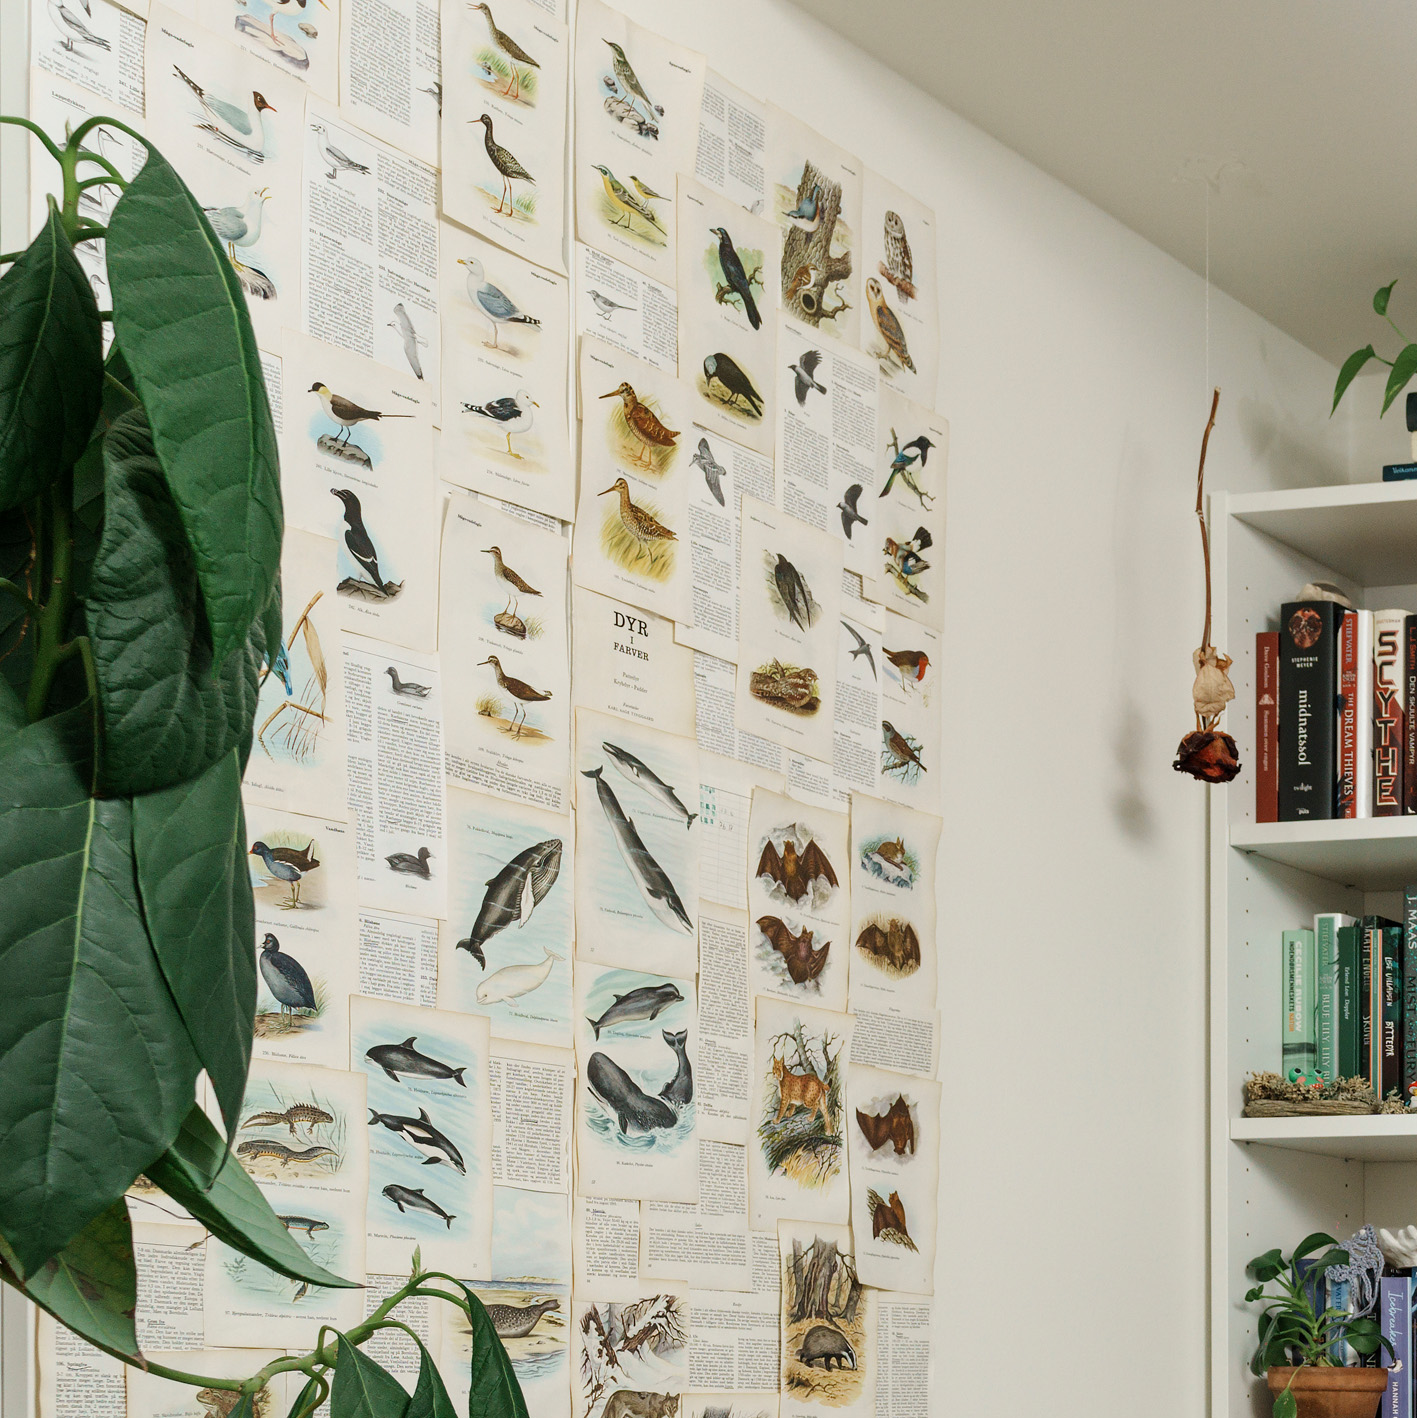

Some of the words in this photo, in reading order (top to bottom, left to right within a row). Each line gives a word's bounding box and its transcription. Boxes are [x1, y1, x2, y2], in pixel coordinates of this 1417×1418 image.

[613, 610, 649, 637] DYR
[613, 642, 649, 661] FARVER
[629, 636, 634, 644] I
[1298, 690, 1311, 765] midnatssol
[1376, 630, 1400, 806] SCYTHE
